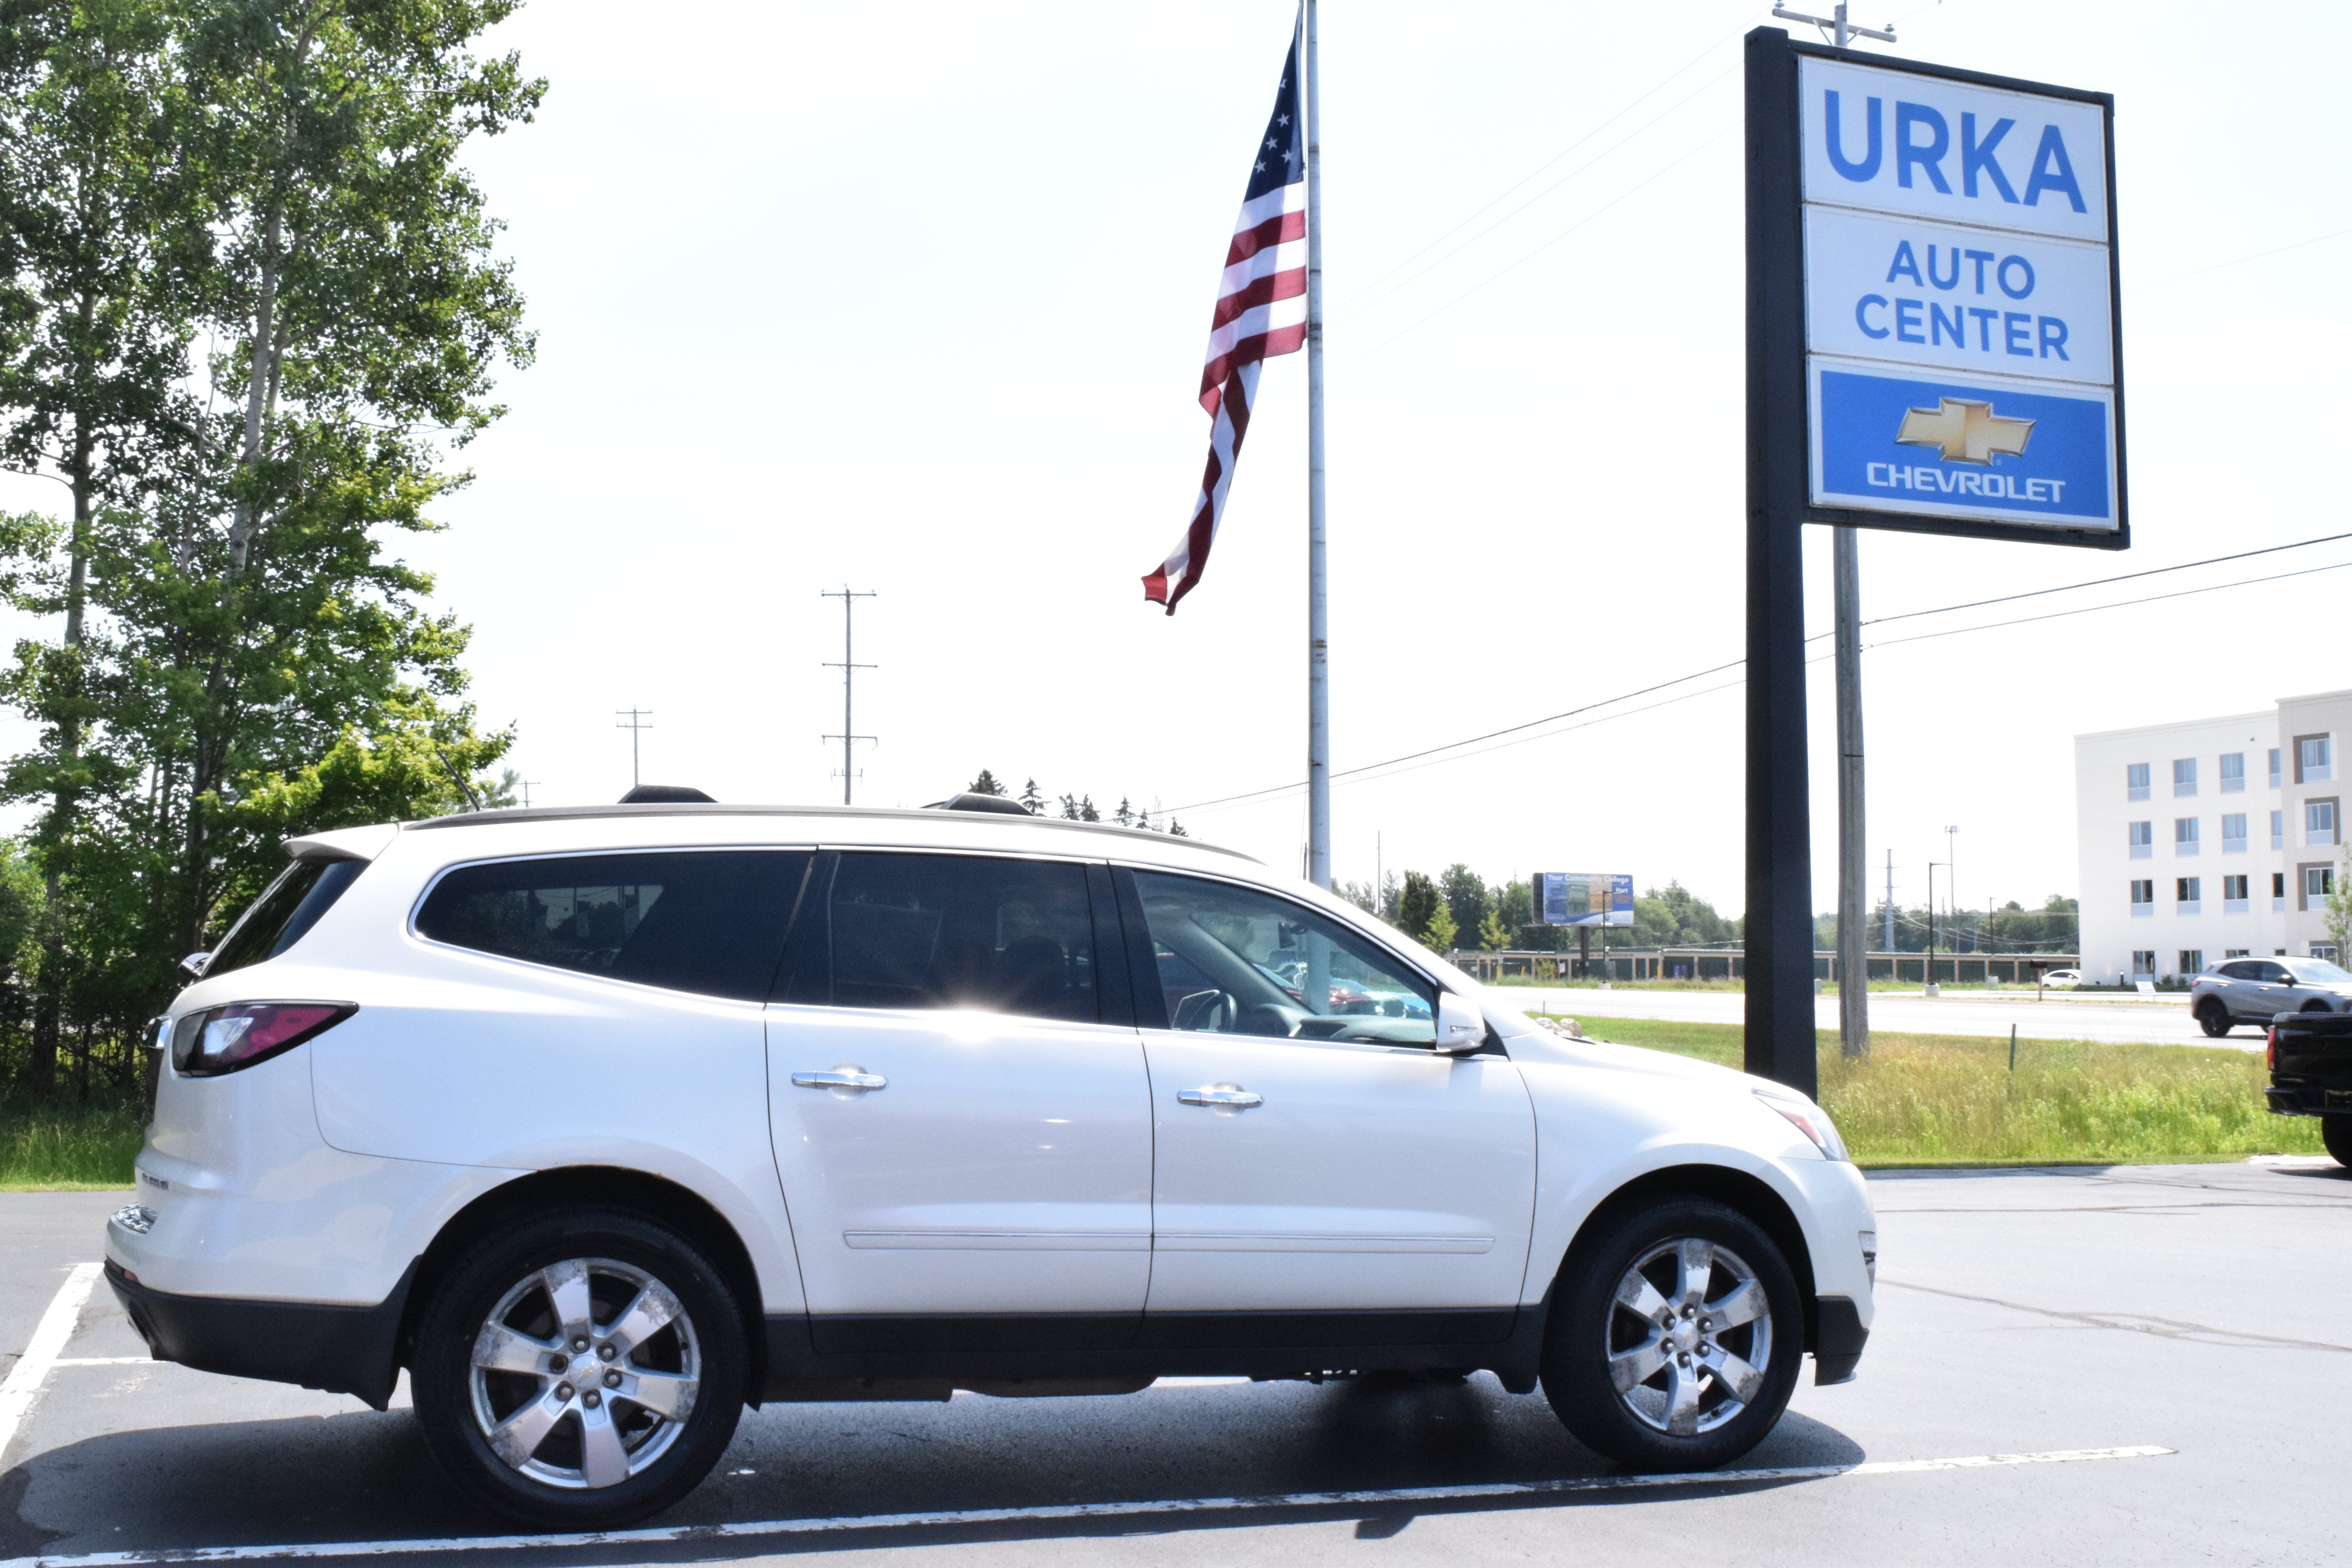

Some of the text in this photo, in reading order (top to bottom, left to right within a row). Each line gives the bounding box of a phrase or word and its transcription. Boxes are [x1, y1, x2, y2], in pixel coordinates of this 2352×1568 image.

[1824, 89, 2087, 214] URKA
[1886, 240, 2035, 299] AUTO
[1855, 294, 2070, 361] CENTER
[1866, 462, 2066, 503] CHEVROLET
[1565, 874, 1603, 883] Community
[1604, 875, 1629, 884] College
